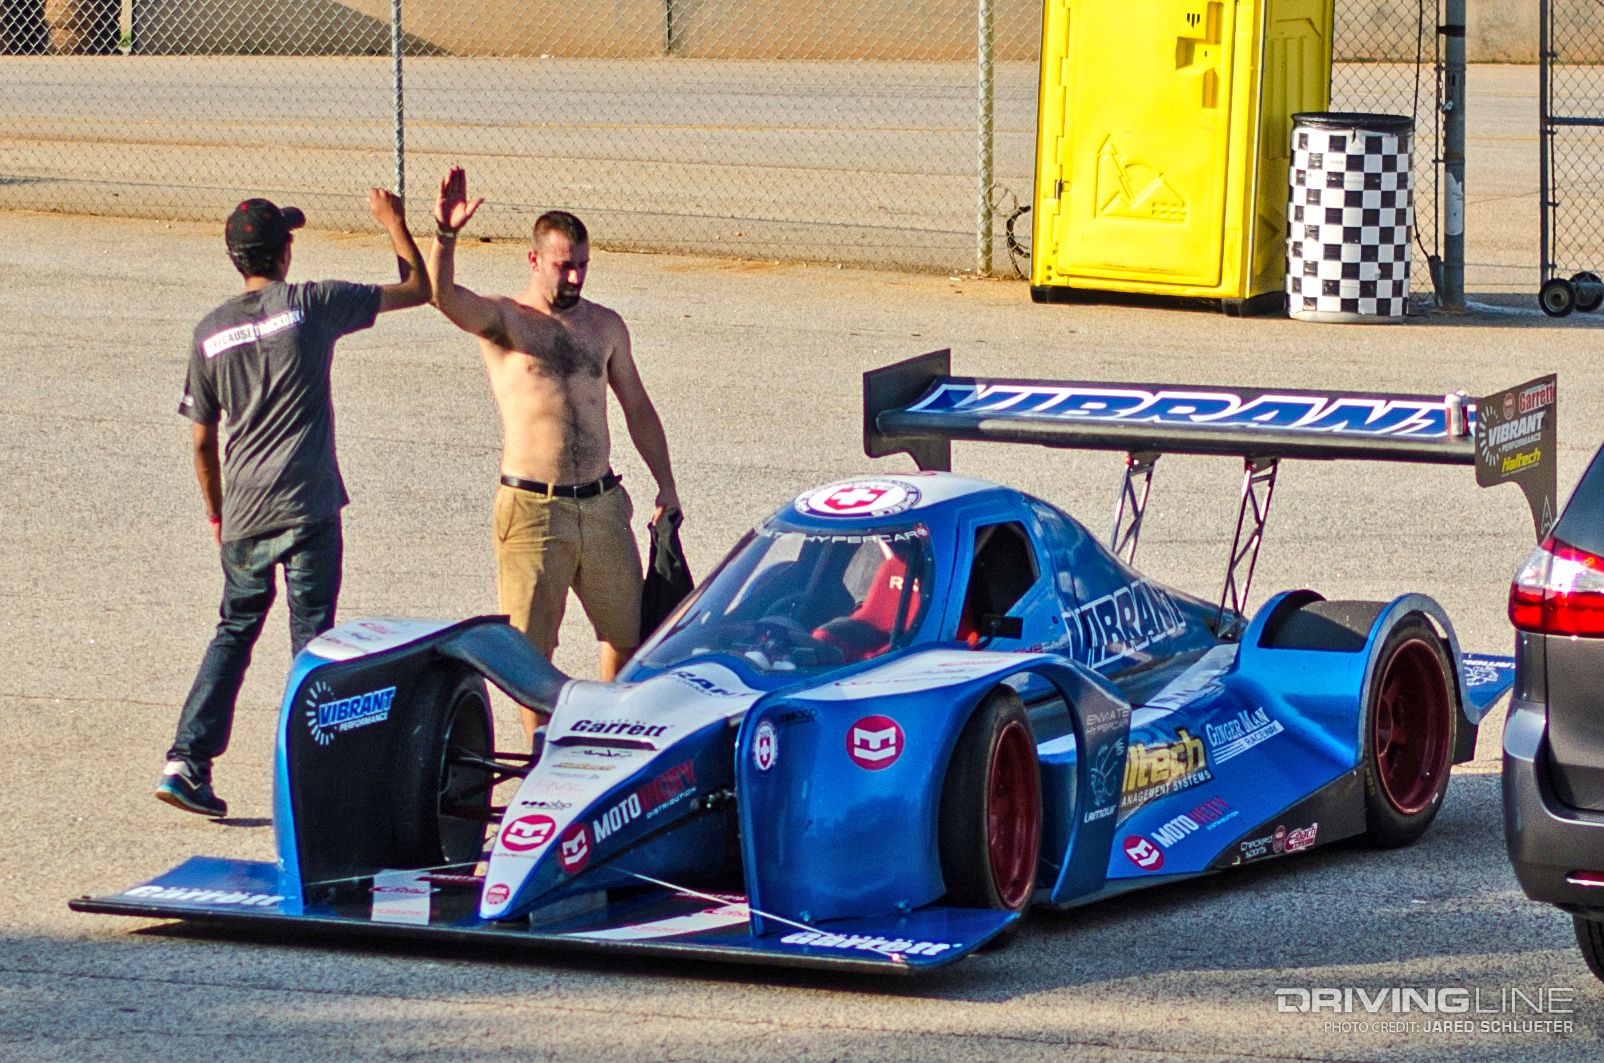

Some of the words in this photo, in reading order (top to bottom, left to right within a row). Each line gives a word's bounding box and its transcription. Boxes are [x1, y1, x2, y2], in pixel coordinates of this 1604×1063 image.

[1519, 384, 1554, 412] Garrett
[1488, 411, 1544, 447] VIBRANT
[1501, 448, 1541, 473] Haltech
[1062, 578, 1186, 669] VIBRANT
[318, 686, 397, 728] VIBRANT
[570, 719, 669, 737] Garrett
[1121, 784, 1171, 807] ANAGEMENT
[1172, 769, 1212, 792] SYSTEMS
